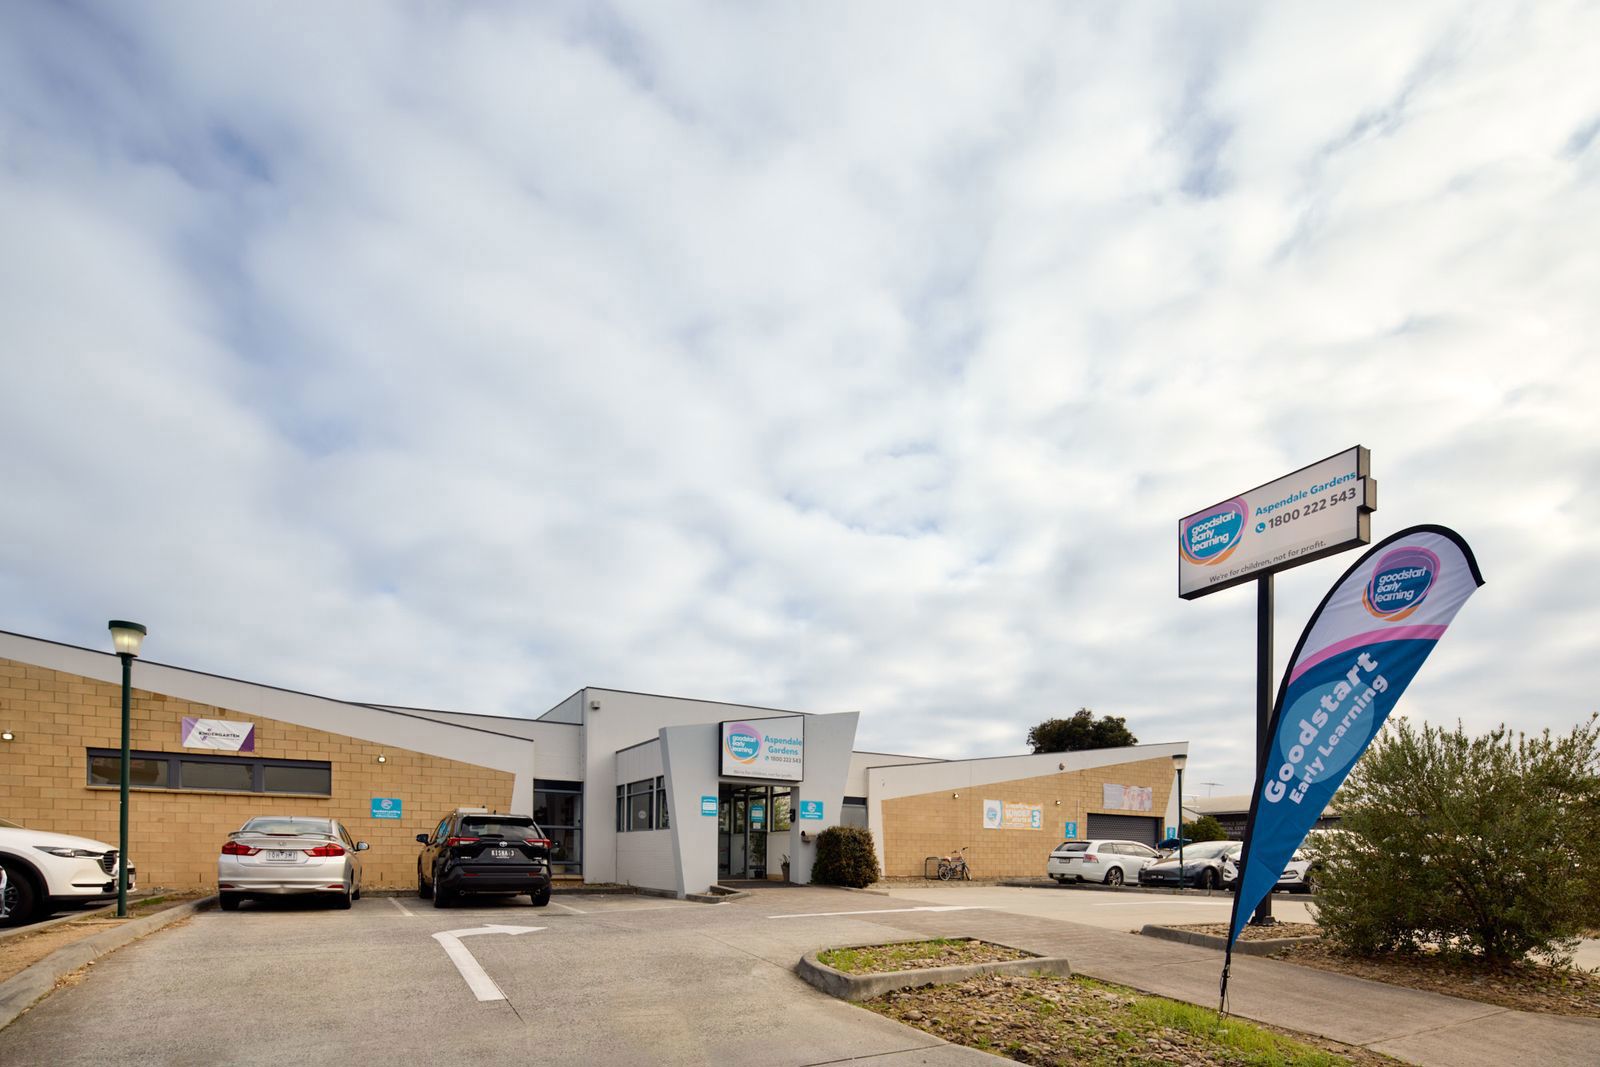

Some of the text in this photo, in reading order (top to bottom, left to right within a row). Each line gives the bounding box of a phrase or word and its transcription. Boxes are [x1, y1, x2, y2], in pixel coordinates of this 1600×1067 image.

[1255, 471, 1357, 516] Aspendale Gardens
[1268, 487, 1357, 529] 1800 222 543
[1191, 510, 1236, 536] goodstart
[1191, 529, 1215, 543] early
[1191, 533, 1229, 553] learning
[1209, 540, 1327, 583] We're for children, not for profit.
[1379, 566, 1427, 586] goodstart
[1375, 590, 1414, 603] learning
[1377, 581, 1402, 593] early
[1264, 652, 1379, 803] Goodstart
[764, 734, 803, 746] Aspendale
[1289, 674, 1389, 805] Early Learning
[768, 745, 800, 755] Gardens
